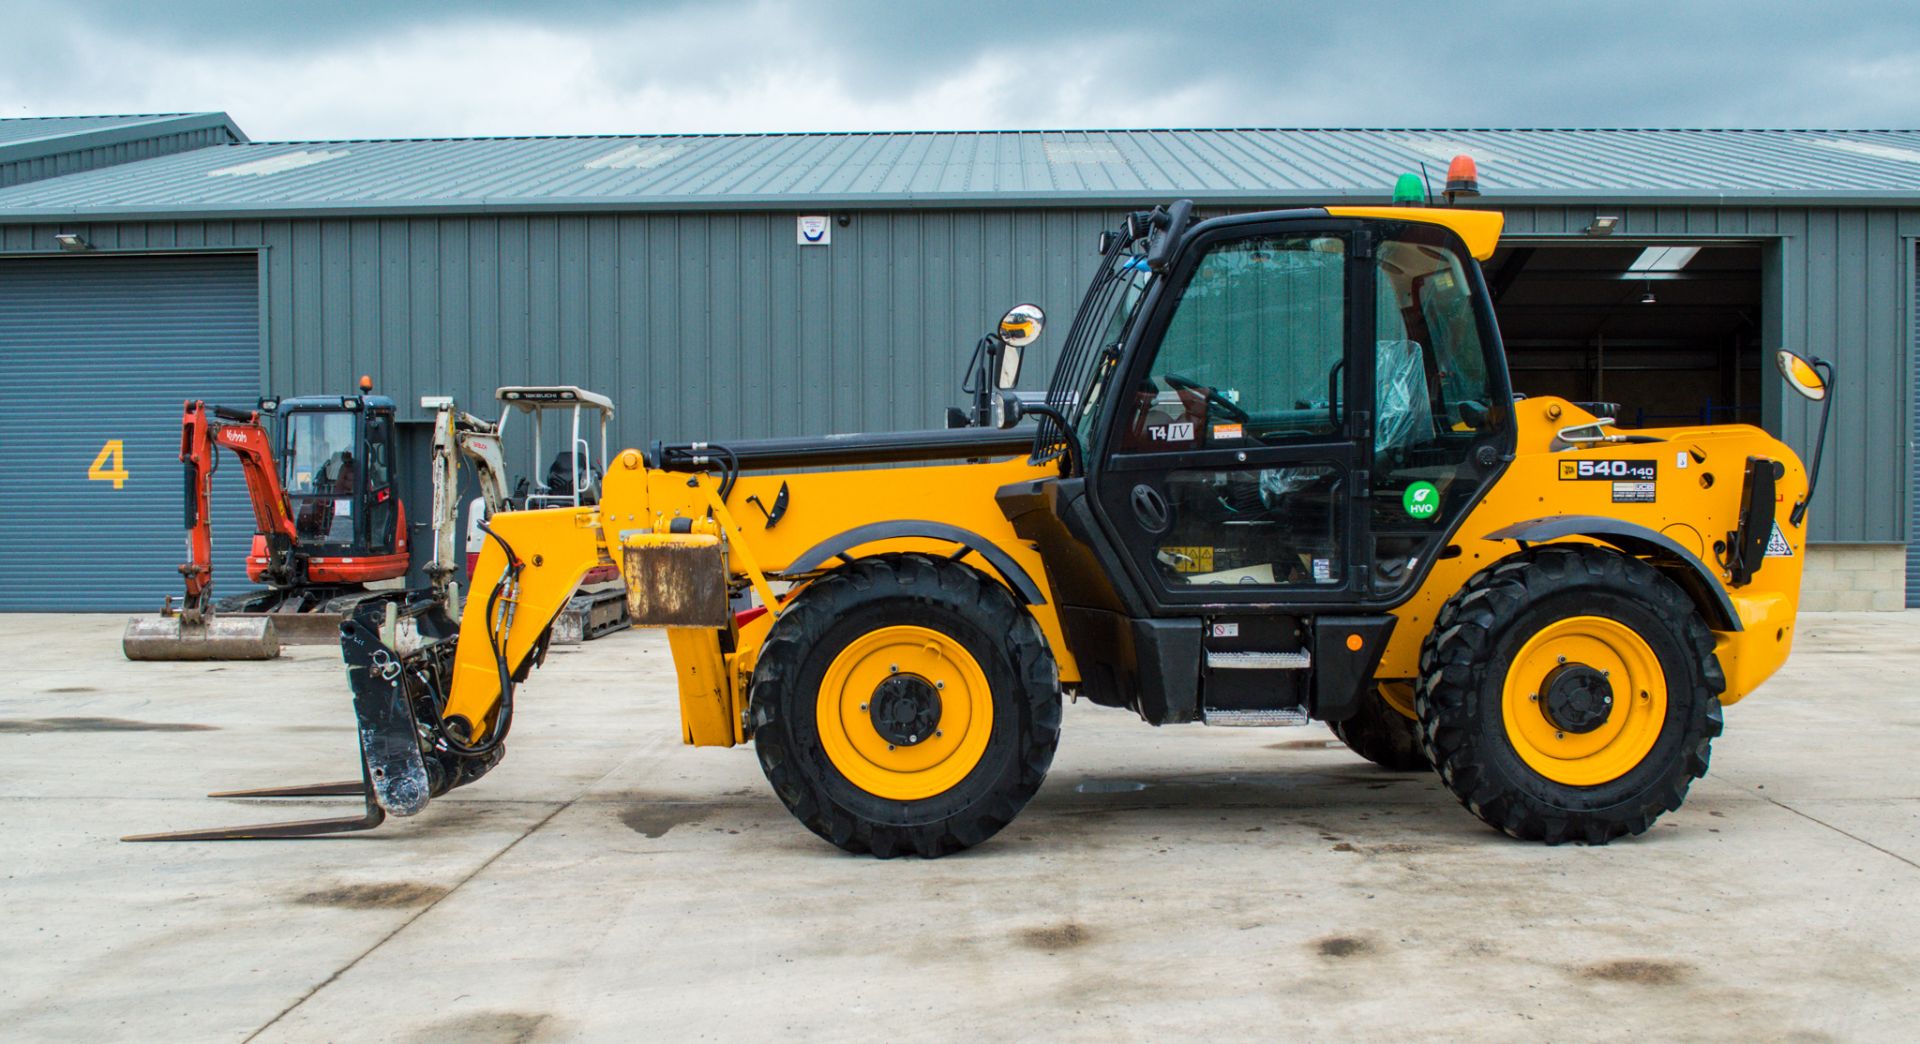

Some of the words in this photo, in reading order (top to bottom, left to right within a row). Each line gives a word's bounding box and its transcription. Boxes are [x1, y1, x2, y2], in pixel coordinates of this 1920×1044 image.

[1149, 426, 1166, 440] T4
[1172, 424, 1190, 439] IV
[88, 439, 128, 489] 4
[1578, 461, 1654, 476] 540-140
[1410, 504, 1433, 513] HVO
